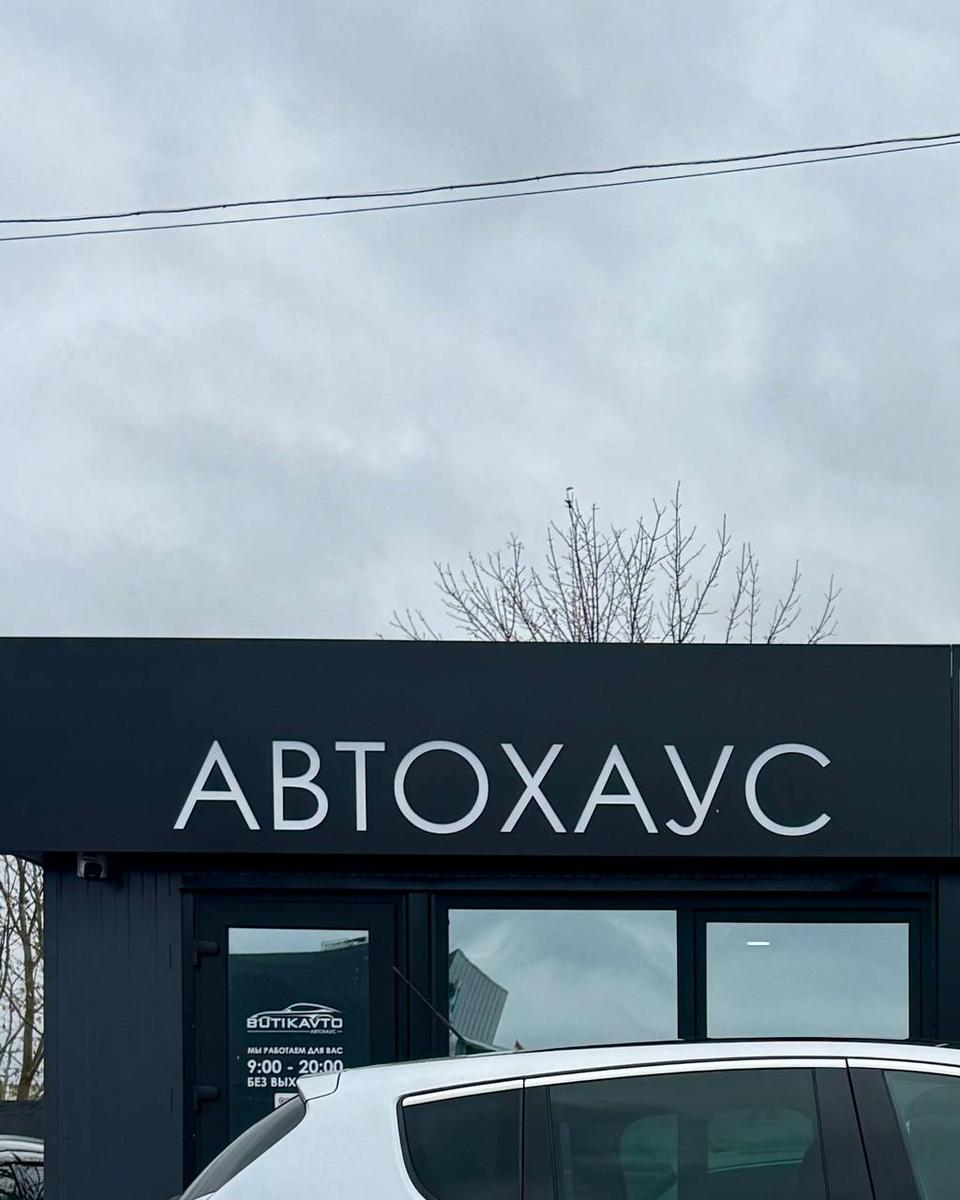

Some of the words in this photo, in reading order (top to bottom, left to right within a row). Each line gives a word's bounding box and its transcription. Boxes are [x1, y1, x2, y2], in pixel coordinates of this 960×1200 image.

[173, 740, 831, 837] АВТОХАУС
[246, 1017, 343, 1028] BUTIKAVTO
[247, 1047, 262, 1055] МЫ
[263, 1047, 306, 1055] РАБОТАЕМ
[307, 1047, 324, 1055] ДЛЯ
[247, 1059, 282, 1074] 9:00
[298, 1059, 344, 1074] 20:00
[247, 1077, 267, 1088] БЕЗ
